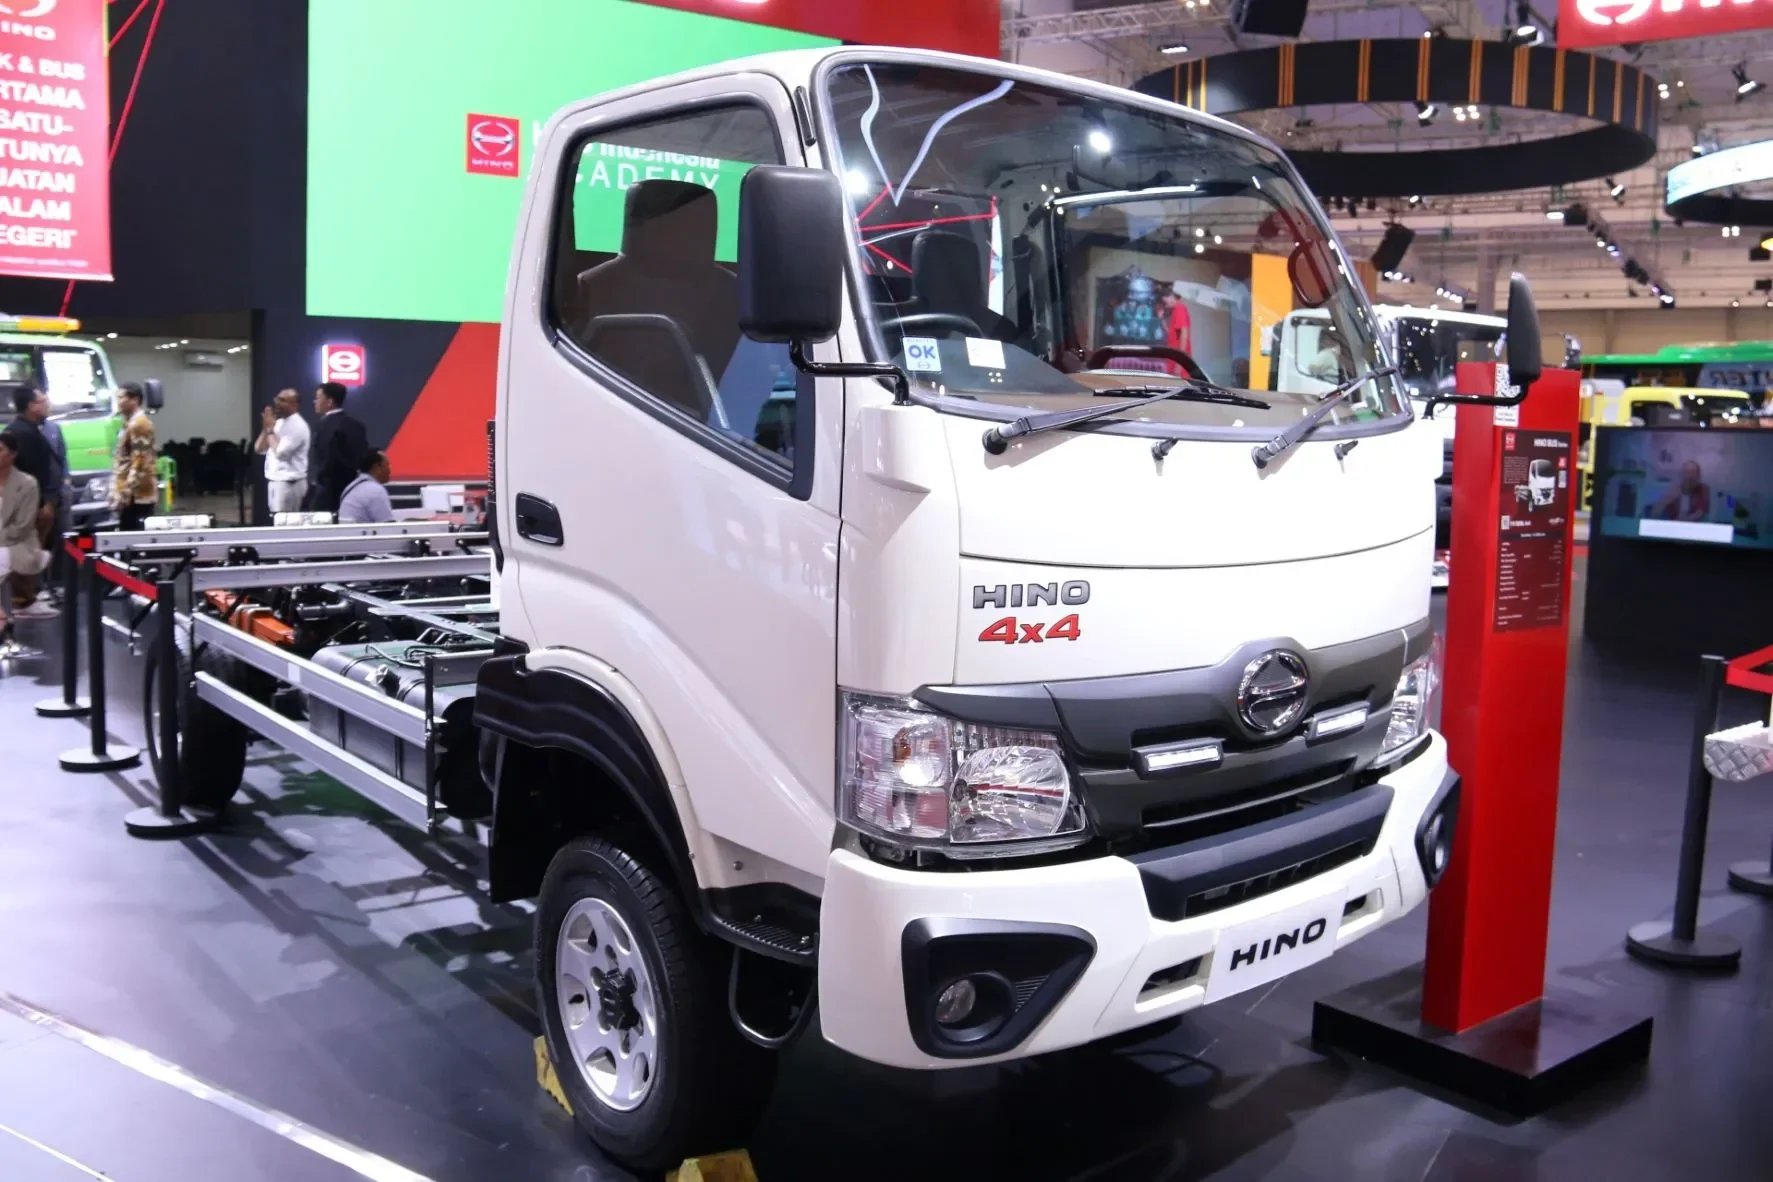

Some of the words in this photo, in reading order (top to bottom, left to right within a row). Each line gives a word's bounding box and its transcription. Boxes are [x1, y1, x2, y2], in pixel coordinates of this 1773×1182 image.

[18, 56, 35, 74] &
[39, 58, 86, 80] BUS
[909, 344, 936, 360] OK
[973, 580, 1090, 609] HINO
[978, 614, 1081, 645] 4x4
[1229, 917, 1327, 971] HINO
